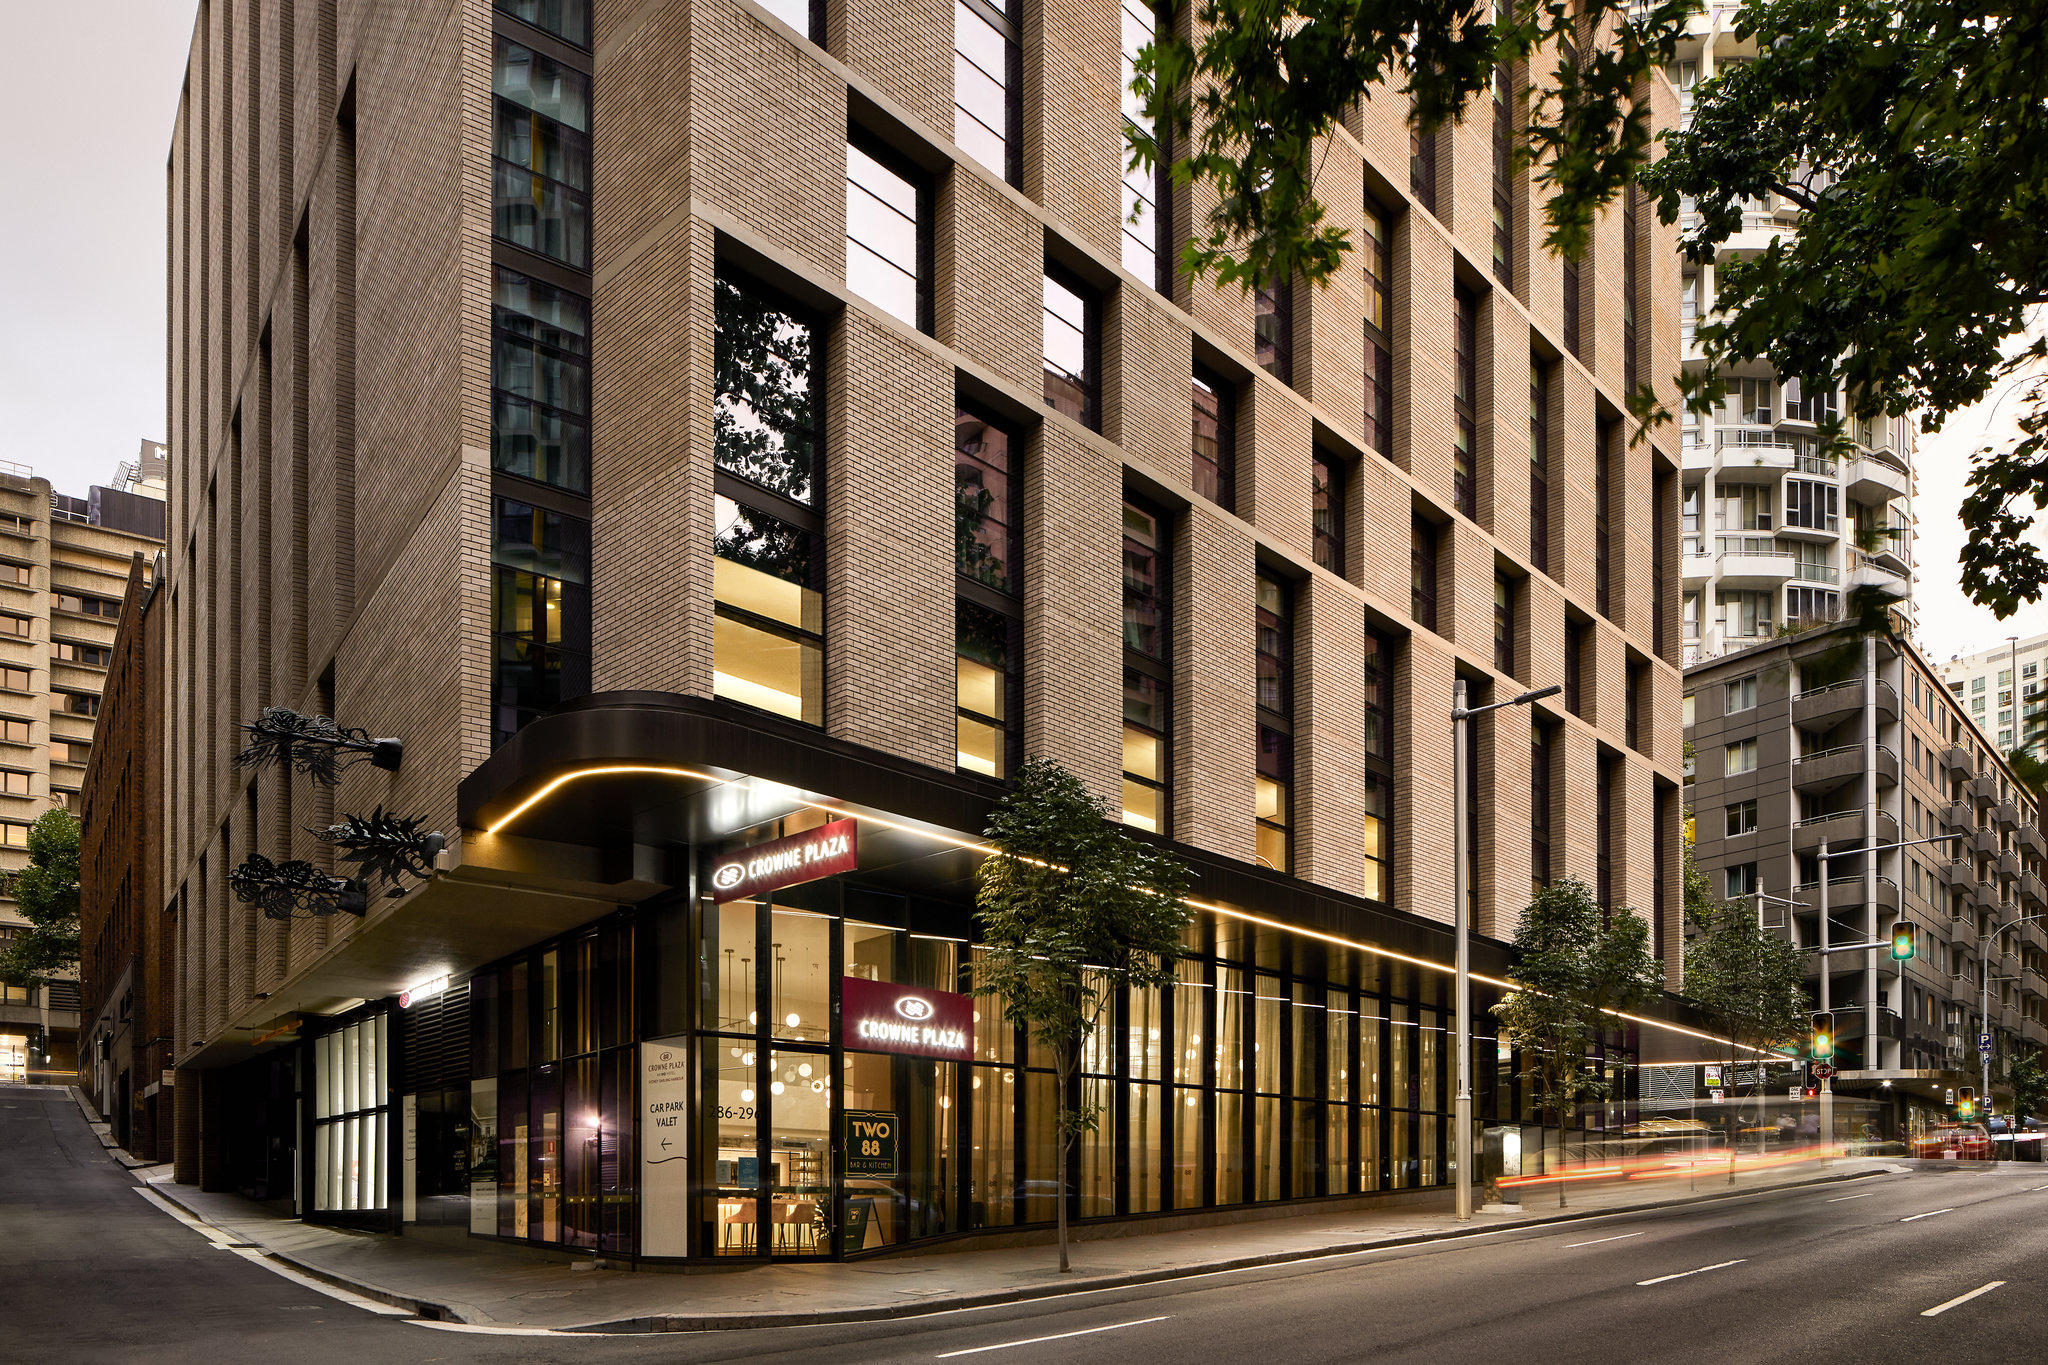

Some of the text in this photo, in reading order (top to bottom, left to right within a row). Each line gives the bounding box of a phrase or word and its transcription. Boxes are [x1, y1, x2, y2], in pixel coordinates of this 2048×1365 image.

[748, 835, 848, 879] CROWNE PLAZA
[859, 1019, 965, 1049] CROWNE PLAZA
[1980, 1035, 1989, 1044] P
[648, 1061, 685, 1072] CROWNE PLAZA
[1816, 1067, 1832, 1076] STOP
[649, 1101, 684, 1113] CAR PARK
[1984, 1096, 1991, 1107] P
[656, 1116, 678, 1127] VALET
[852, 1121, 890, 1138] TWO
[861, 1139, 880, 1156] 88
